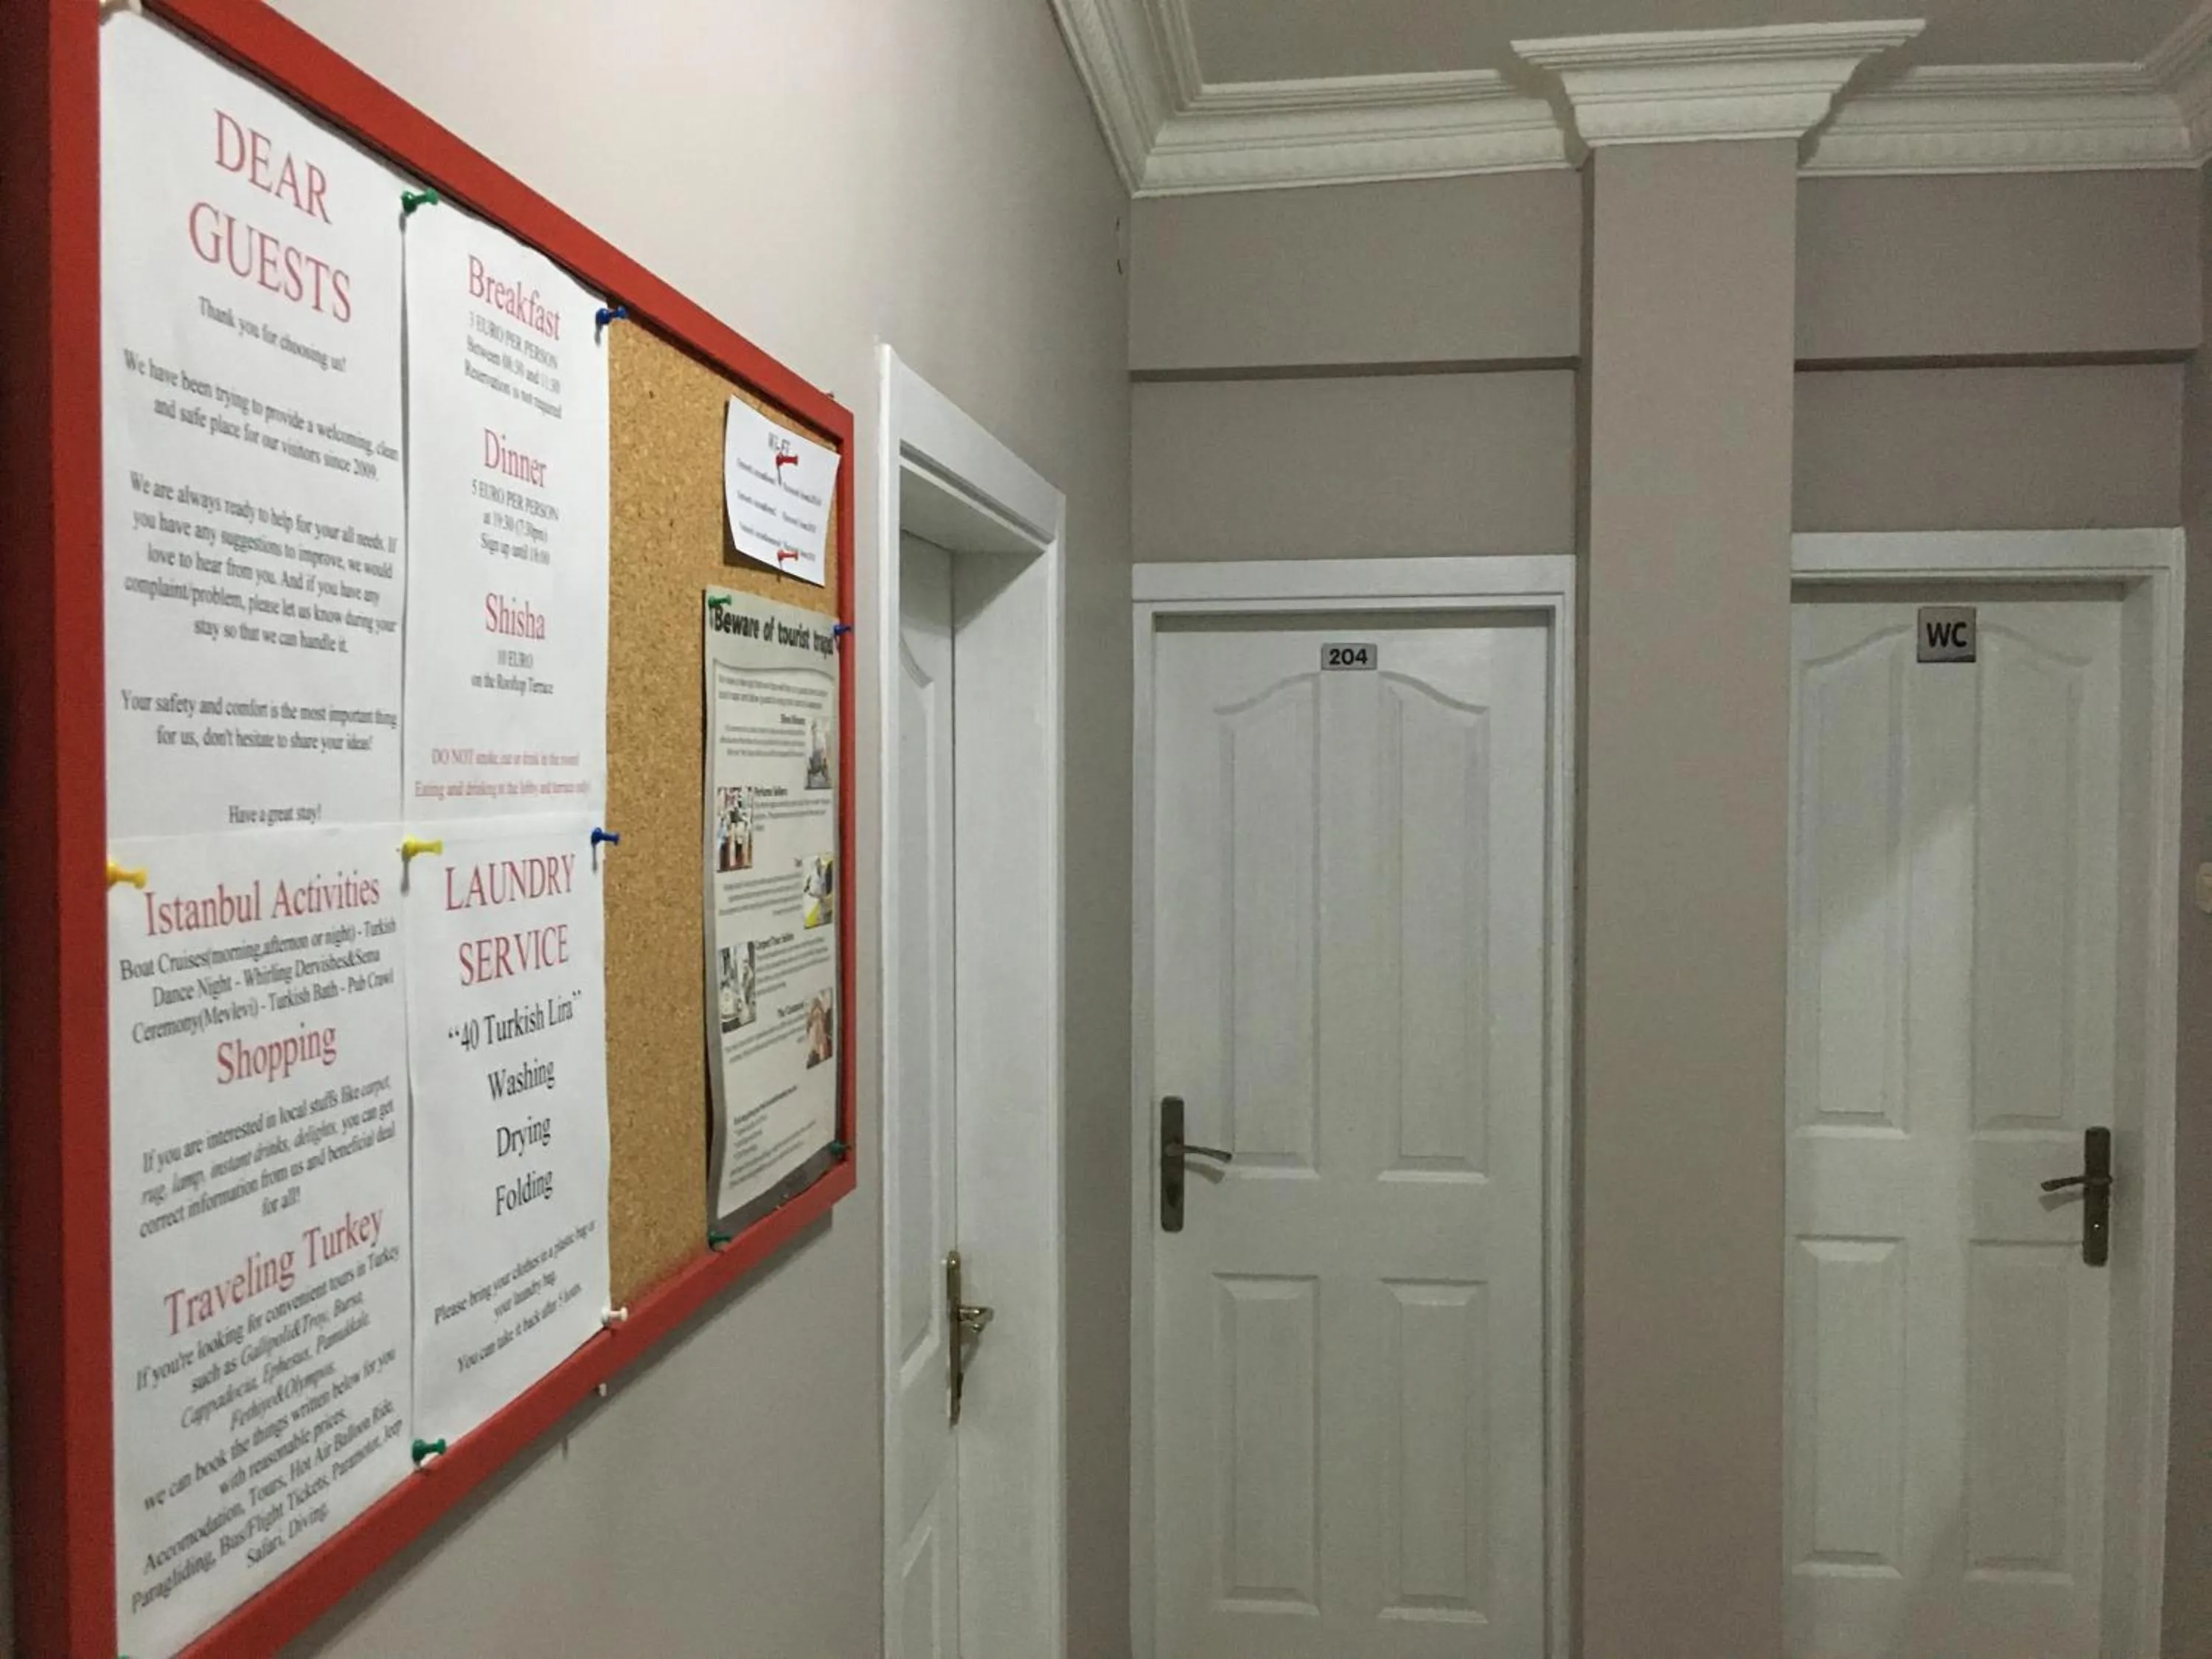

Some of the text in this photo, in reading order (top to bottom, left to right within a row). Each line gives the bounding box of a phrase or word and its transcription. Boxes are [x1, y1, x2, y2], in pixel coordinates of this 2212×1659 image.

[214, 108, 332, 226] DEAR
[189, 201, 351, 323] GUESTS
[469, 254, 560, 341] Breakfast
[198, 296, 327, 371] Thank for choosing
[505, 330, 558, 369] PER PERSON
[124, 349, 313, 432] We have been trying to provide a
[154, 398, 351, 472] and safe place for our visitors since
[484, 427, 547, 488] Dinner
[130, 471, 355, 543] We are always ready to help for your all
[472, 479, 559, 521] 5 EURO PER PERSON
[133, 510, 393, 579] you have any suggestions to we would
[148, 543, 380, 606] love to hear from And if you have any
[194, 618, 335, 651] stay so that we can handle
[248, 594, 397, 634] please let us know during your
[485, 593, 546, 640] Shisha
[714, 605, 759, 639] Beware
[763, 616, 774, 641] of
[779, 621, 810, 650] tourist
[1927, 622, 1967, 648] WC
[508, 650, 533, 668] EURO
[1329, 649, 1368, 665] 204
[121, 689, 326, 721] Your safety and comfort is the most
[156, 726, 344, 754] for us, don't hesitate to share your
[432, 748, 473, 765] DO NOT
[229, 804, 321, 826] Have a great stay!
[143, 870, 380, 936] Istanbul Activities
[445, 854, 575, 911] LAUNDRY
[119, 919, 397, 981] Boat or Turkish
[459, 924, 569, 987] SERVICE
[153, 962, 293, 1007] Dance Night Whirling
[268, 986, 310, 1012] Turkish
[313, 980, 338, 1001] Bath
[347, 976, 366, 994] Pub
[369, 968, 394, 989] Crawl
[484, 1003, 544, 1045] Turkish
[217, 1021, 337, 1085] Shopping
[487, 1057, 554, 1101] Washing
[142, 1085, 359, 1173] If you are interested in local like
[341, 1099, 394, 1135] you can get
[496, 1116, 552, 1157] Drying
[139, 1149, 325, 1238] correct information from us and
[261, 1194, 277, 1217] for
[495, 1171, 553, 1217] Folding
[164, 1208, 383, 1336] Traveling Turkey
[136, 1268, 355, 1391] If you're looking for tours
[434, 1299, 467, 1325] Please
[190, 1357, 237, 1392] such as
[145, 1415, 290, 1511] we can book the things
[218, 1429, 311, 1495] with reasonable
[290, 1443, 332, 1481] Hot Air
